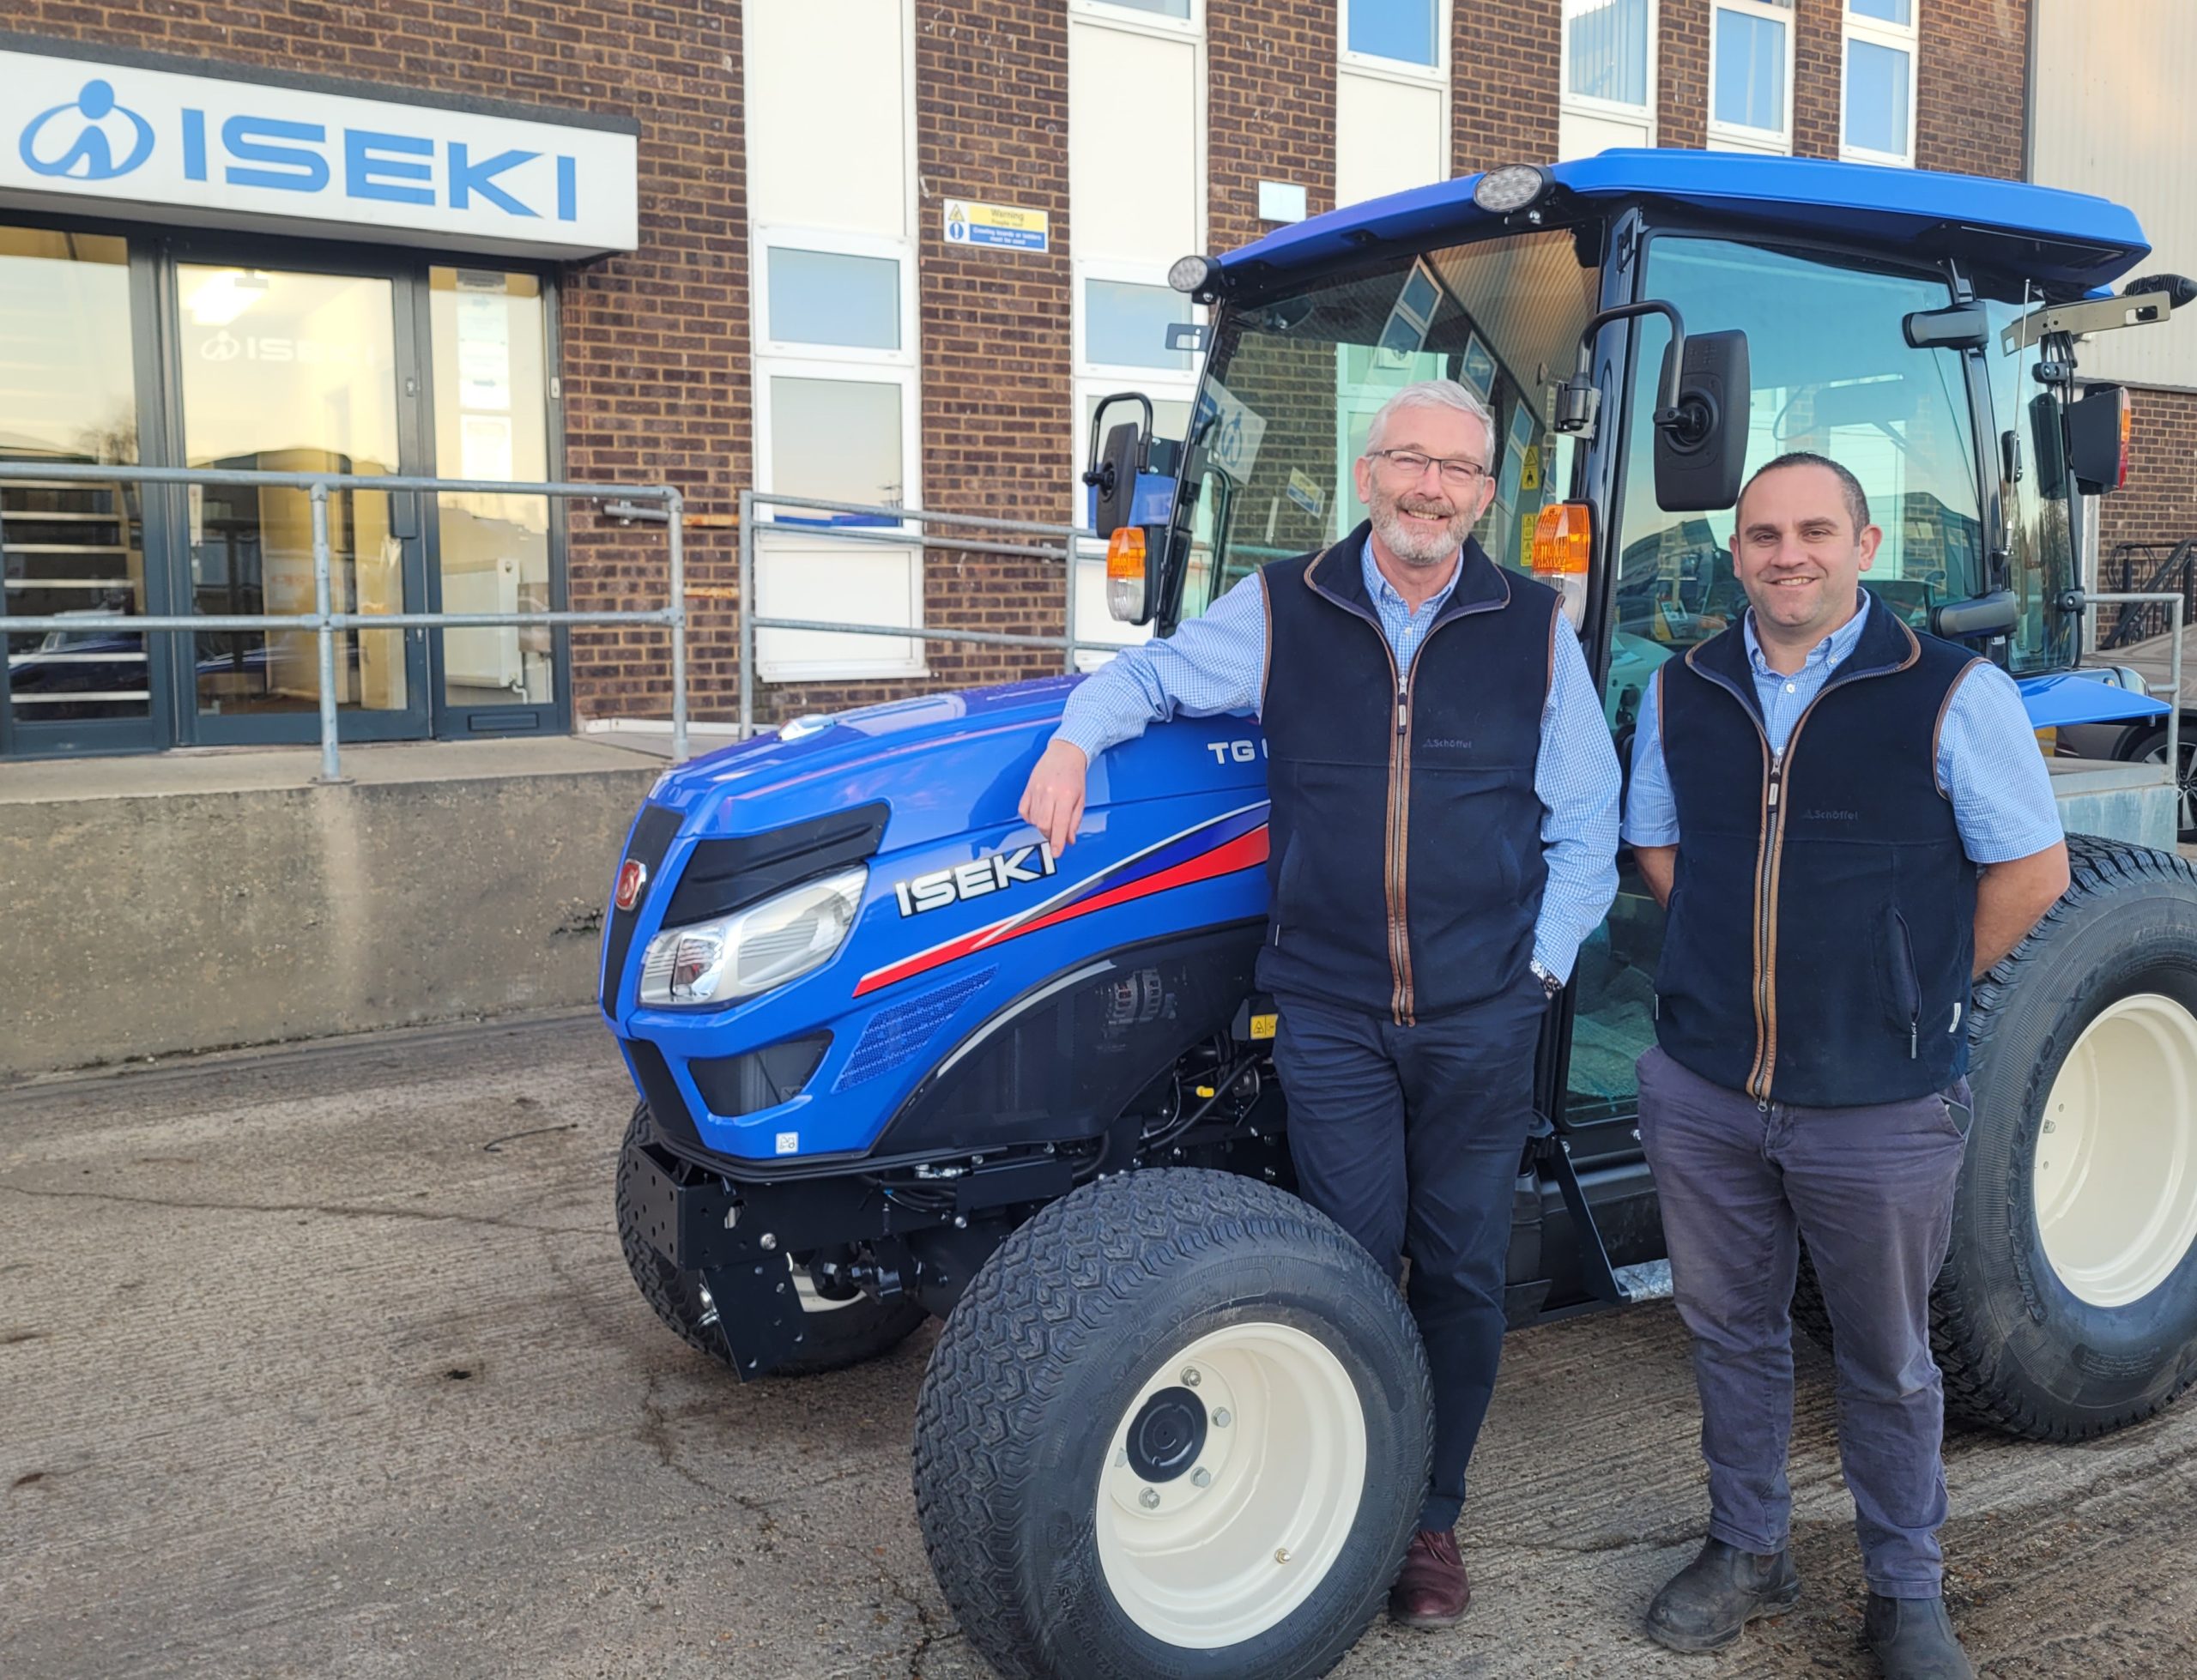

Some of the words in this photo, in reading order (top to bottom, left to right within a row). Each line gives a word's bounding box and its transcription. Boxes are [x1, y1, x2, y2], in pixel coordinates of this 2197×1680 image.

[182, 108, 577, 221] ISEKI
[990, 208, 1024, 221] Warning
[1207, 740, 1256, 764] TG
[894, 840, 1056, 917] ISEKI
